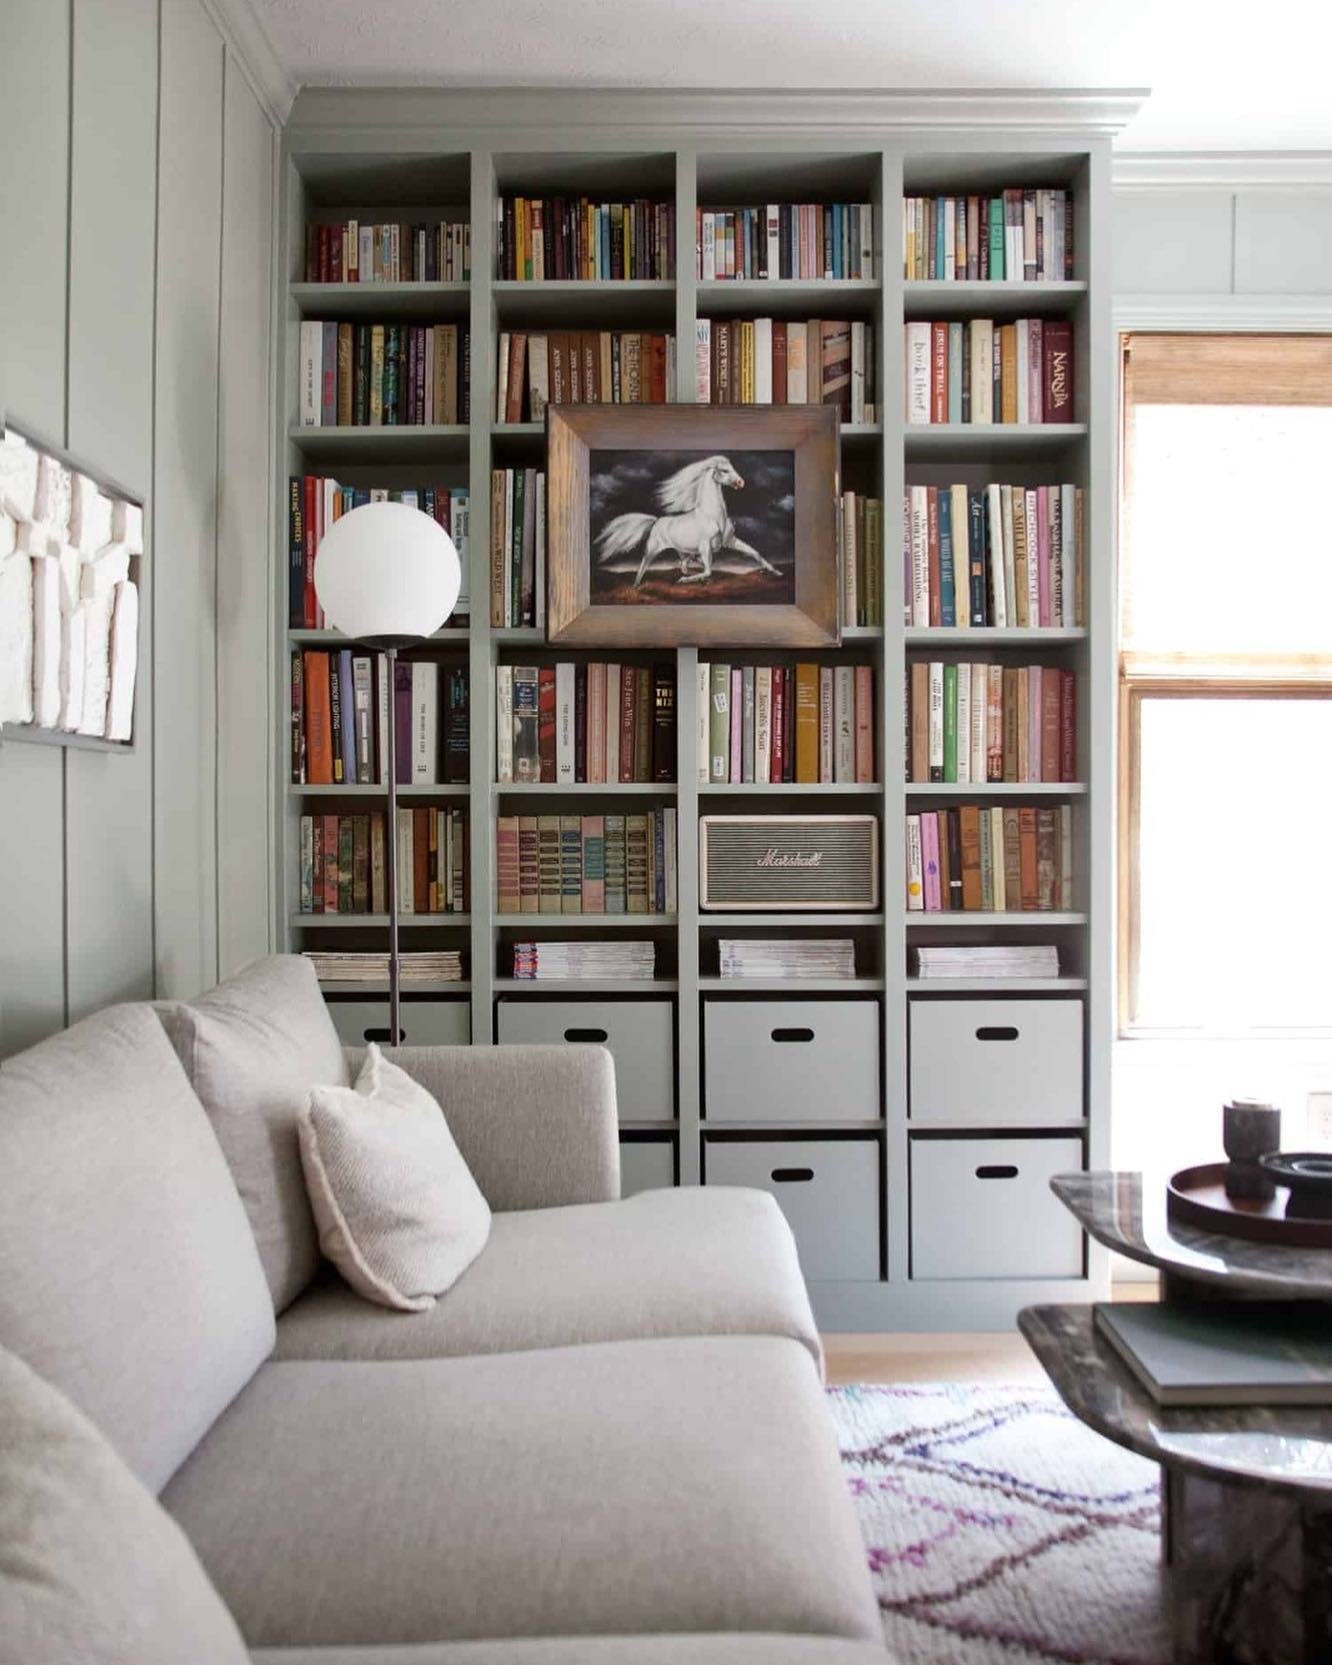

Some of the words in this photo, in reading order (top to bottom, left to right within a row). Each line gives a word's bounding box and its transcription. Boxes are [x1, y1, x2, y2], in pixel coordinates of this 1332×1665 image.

[936, 328, 944, 354] JESUS
[914, 342, 926, 375] book
[936, 355, 944, 368] ON
[914, 378, 926, 410] thief
[936, 369, 944, 393] TRIAL
[1051, 352, 1068, 408] NARNIA
[291, 481, 299, 512] MAKING
[294, 511, 302, 543] CHOICES
[913, 510, 921, 539] MODEL
[1014, 514, 1026, 560] MILLER
[1027, 494, 1037, 565] HITCHCOCK
[495, 549, 503, 572] WILD
[913, 543, 922, 603] RAILROADING
[1030, 568, 1039, 603] STYLE
[331, 673, 339, 700] INTERIOR
[625, 668, 633, 686] See
[624, 688, 633, 708] Jane
[333, 701, 341, 730] LIGHTING
[624, 710, 633, 727] Win
[756, 848, 823, 867] Marshall
